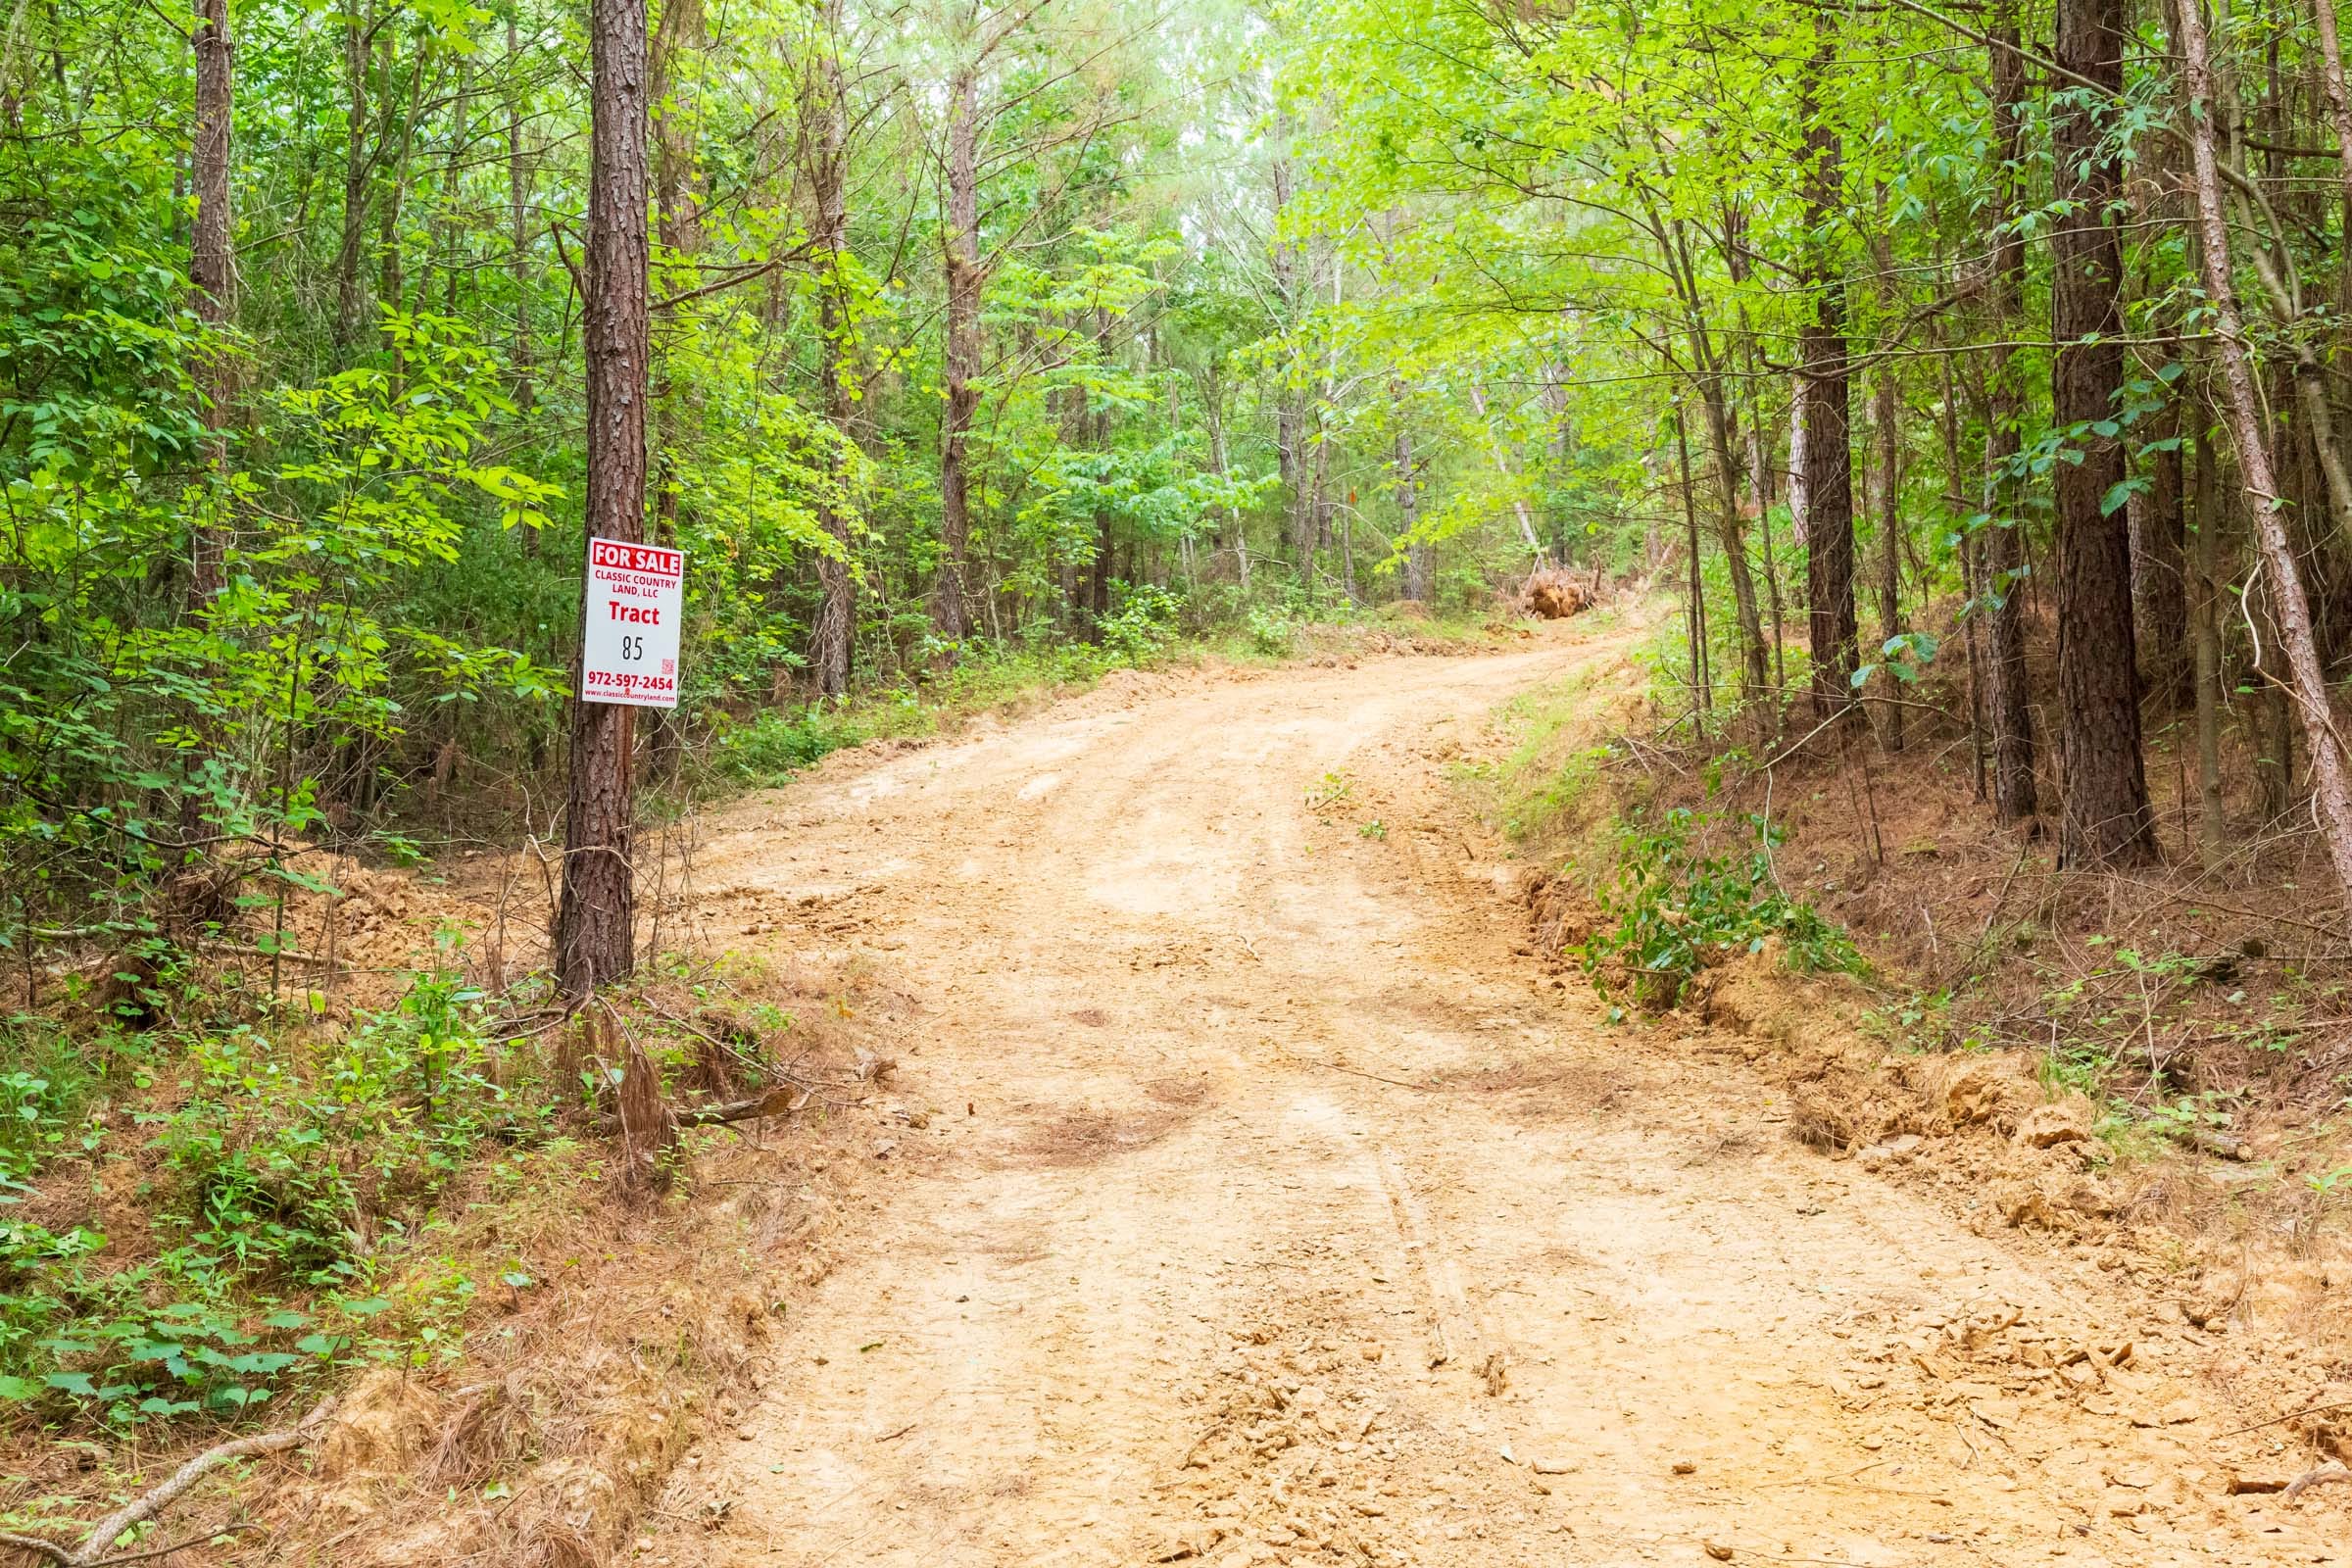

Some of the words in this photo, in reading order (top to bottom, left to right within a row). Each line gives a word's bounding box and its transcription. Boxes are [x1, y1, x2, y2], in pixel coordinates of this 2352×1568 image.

[595, 544, 630, 566] FOR
[635, 551, 678, 574] SALE
[595, 569, 631, 583] CLASSIC
[633, 575, 676, 589] COUNTRY
[612, 584, 640, 597] LAND,
[643, 589, 659, 598] LLC
[609, 601, 660, 624] Tract
[622, 636, 643, 661] 85
[588, 671, 673, 690] 972-597-2454
